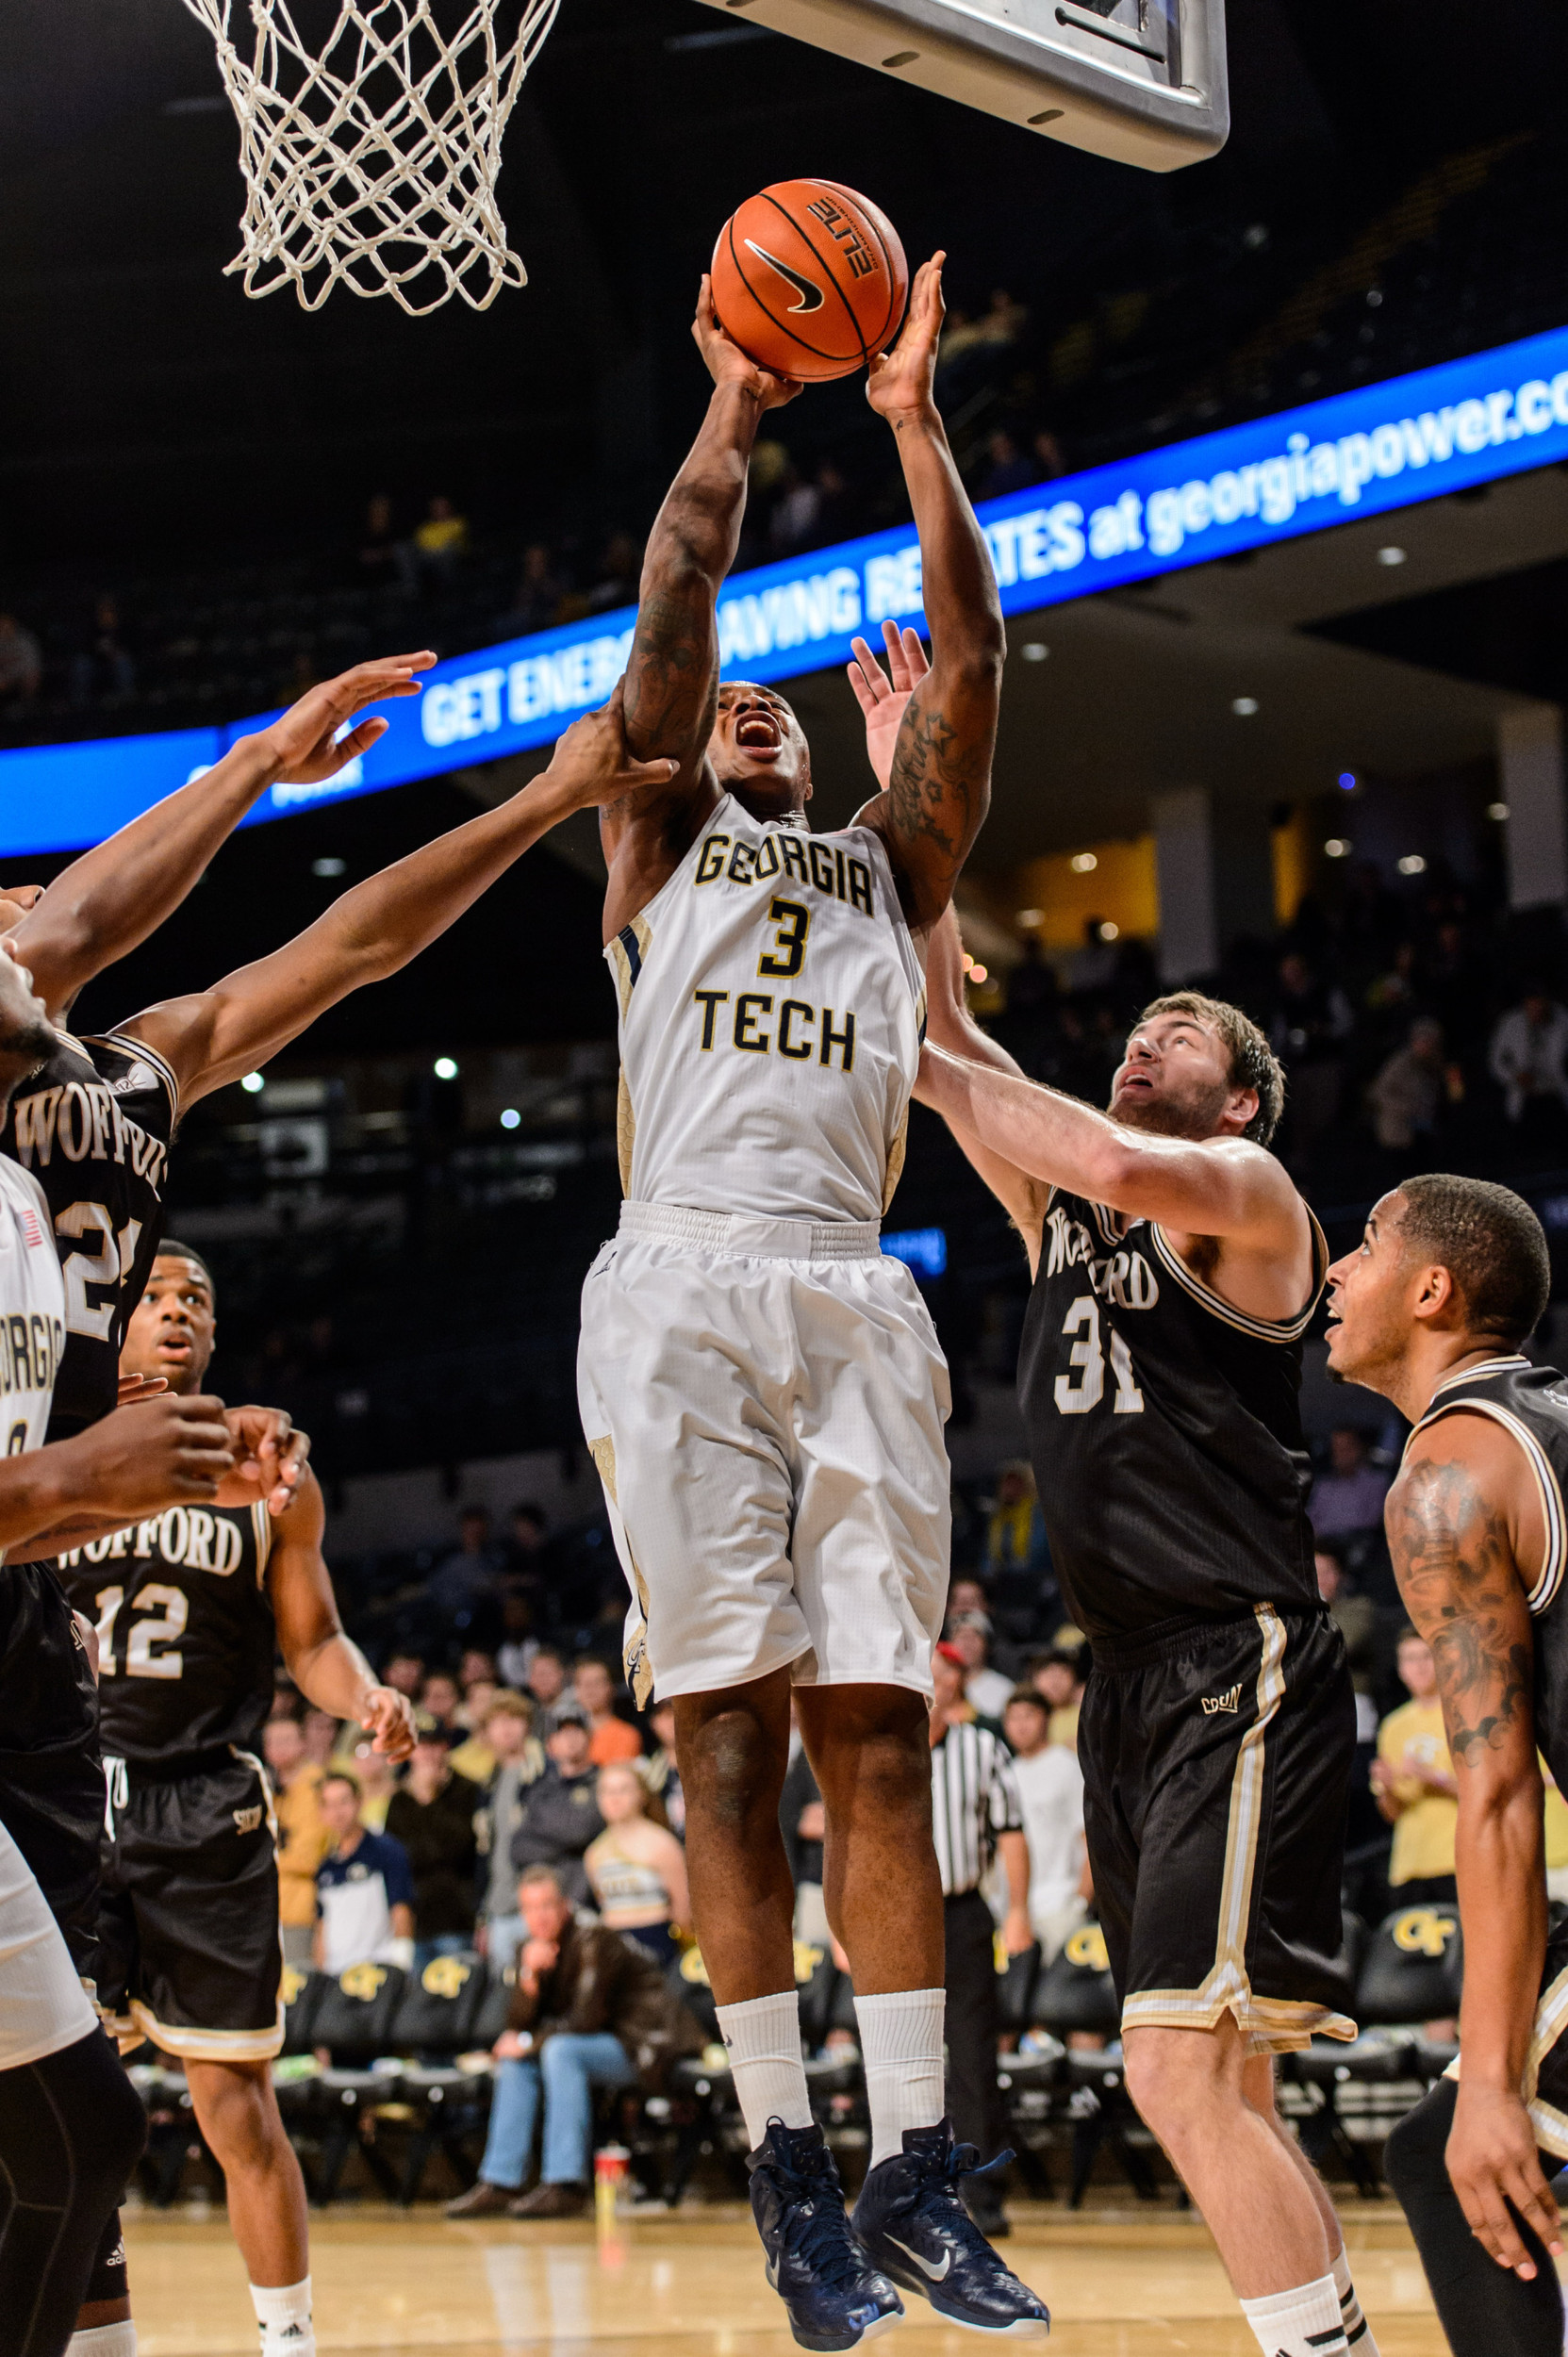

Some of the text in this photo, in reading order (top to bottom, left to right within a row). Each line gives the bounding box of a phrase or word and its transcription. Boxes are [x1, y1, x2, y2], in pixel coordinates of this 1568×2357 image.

[806, 197, 875, 279] ELITE
[421, 667, 506, 748] GET
[719, 567, 862, 667] AVING
[1088, 488, 1144, 560] at
[694, 833, 875, 919] GEORGIA
[757, 896, 811, 980] 3
[694, 989, 856, 1073] TECH
[1053, 1295, 1145, 1414] 31
[94, 1583, 189, 1679] 12
